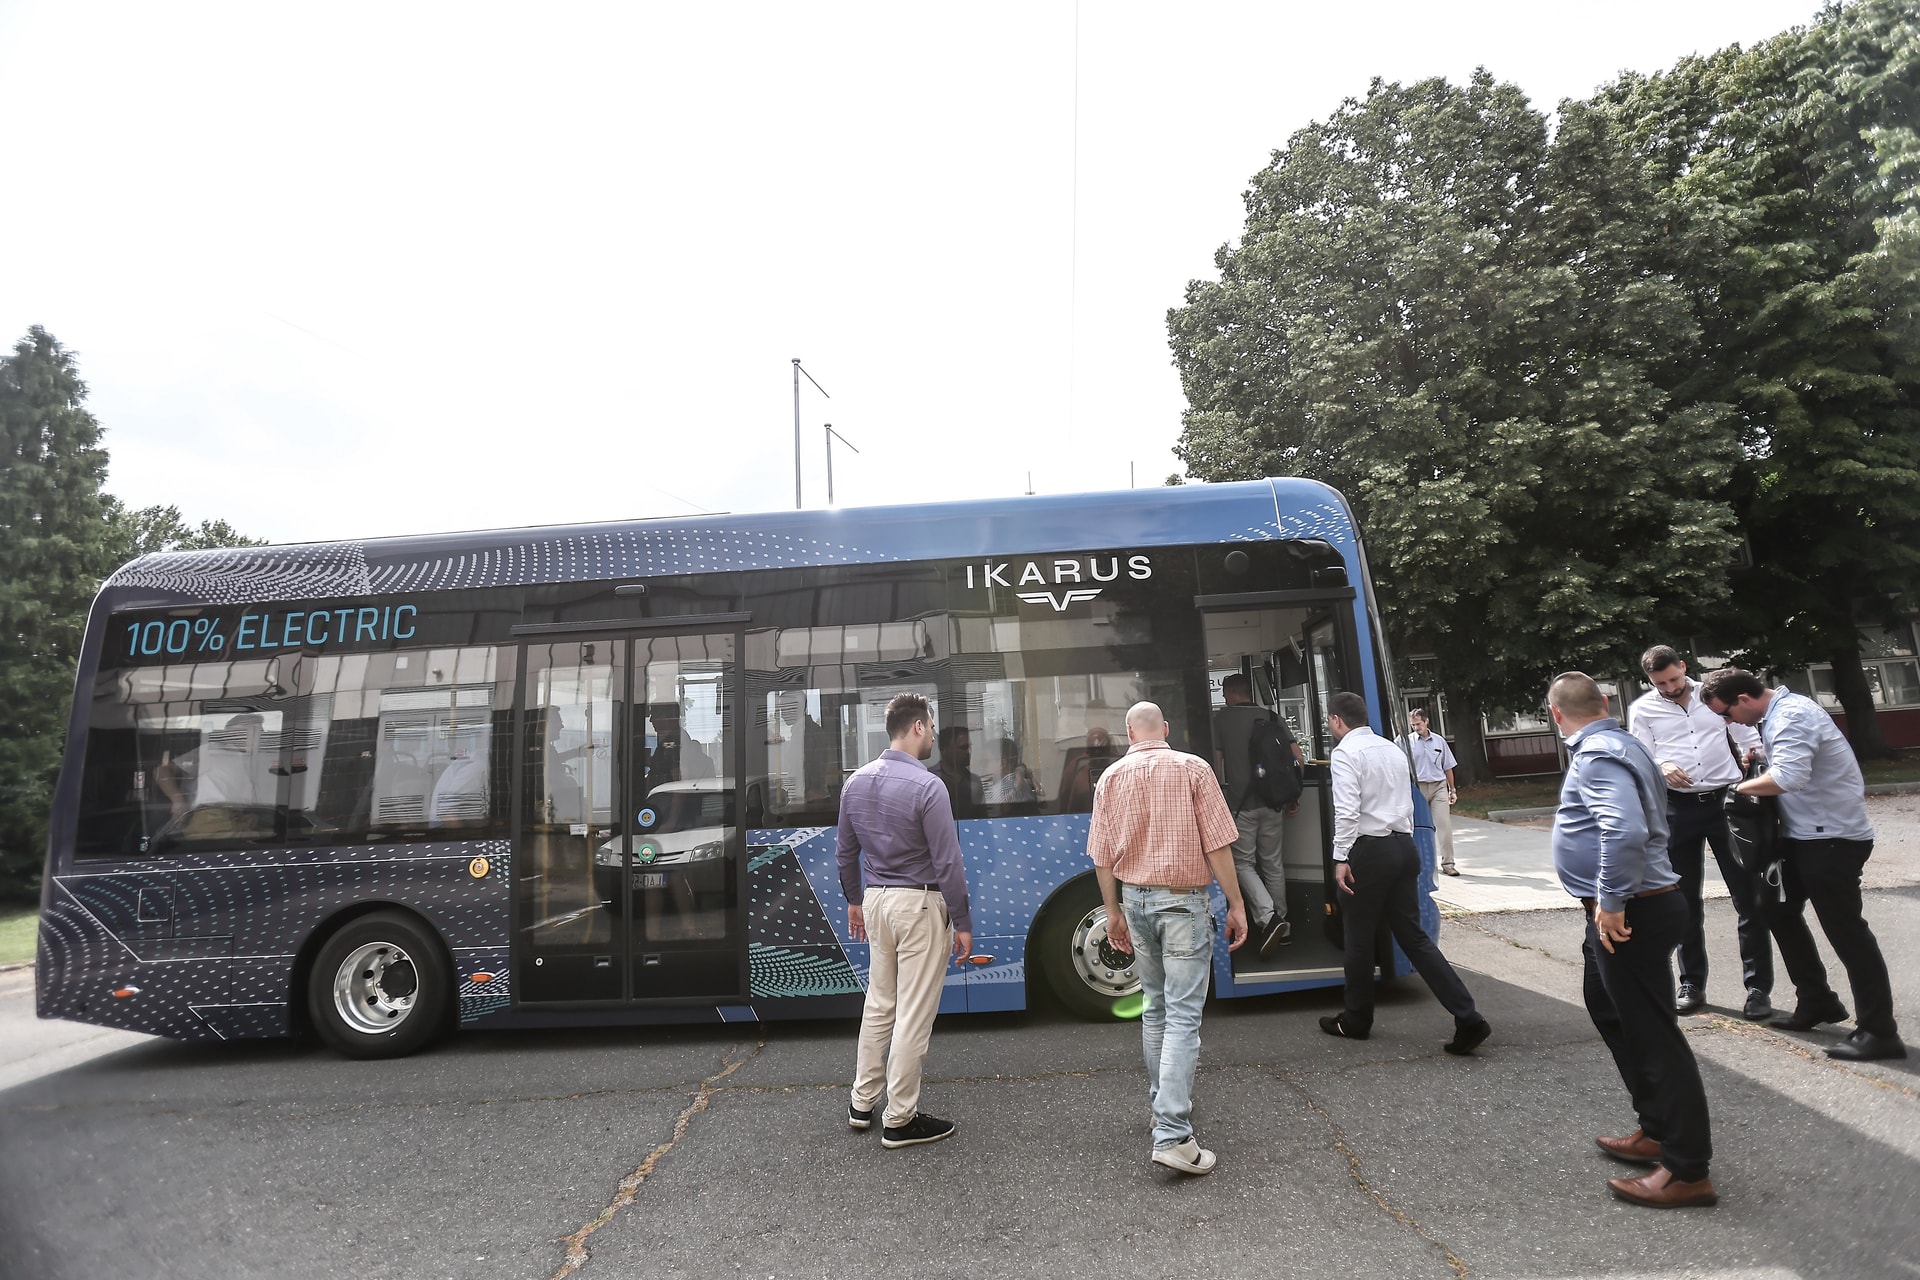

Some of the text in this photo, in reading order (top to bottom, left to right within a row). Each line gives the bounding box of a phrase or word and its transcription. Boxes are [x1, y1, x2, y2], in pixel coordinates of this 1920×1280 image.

[966, 555, 1152, 589] IKARUS
[127, 604, 417, 656] 100% ELECTRIC
